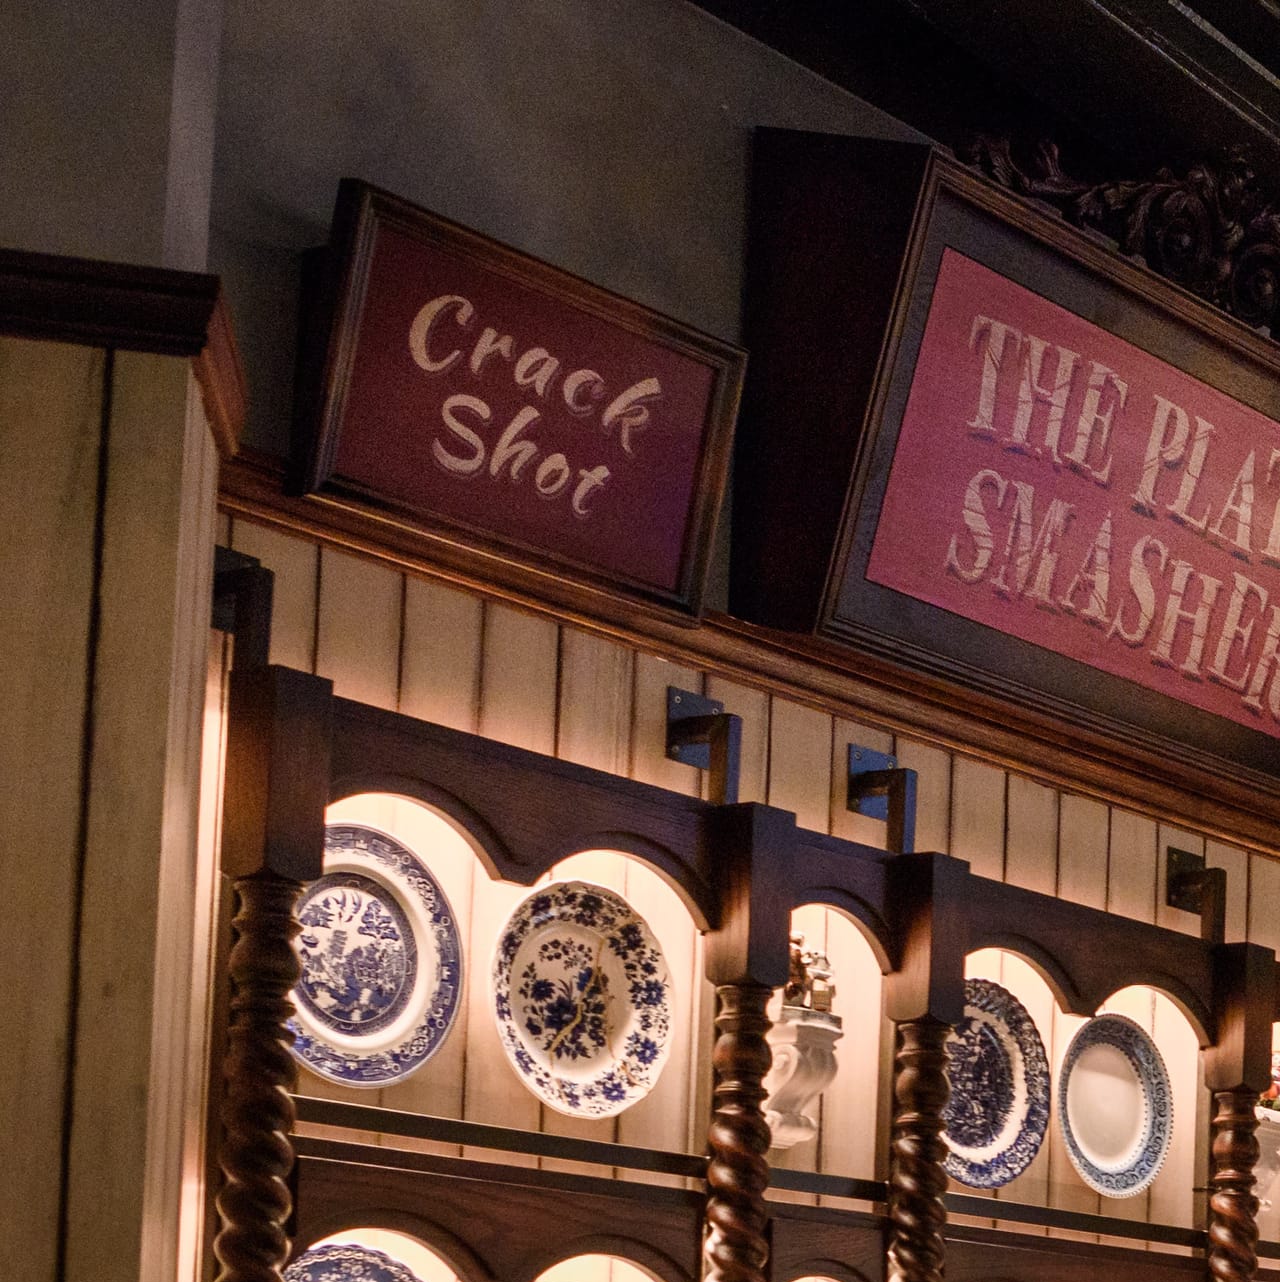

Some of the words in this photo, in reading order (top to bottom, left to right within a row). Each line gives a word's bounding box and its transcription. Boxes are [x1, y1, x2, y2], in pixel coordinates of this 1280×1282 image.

[408, 294, 662, 454] Crack
[966, 314, 1128, 484] THE
[432, 393, 611, 516] Shot
